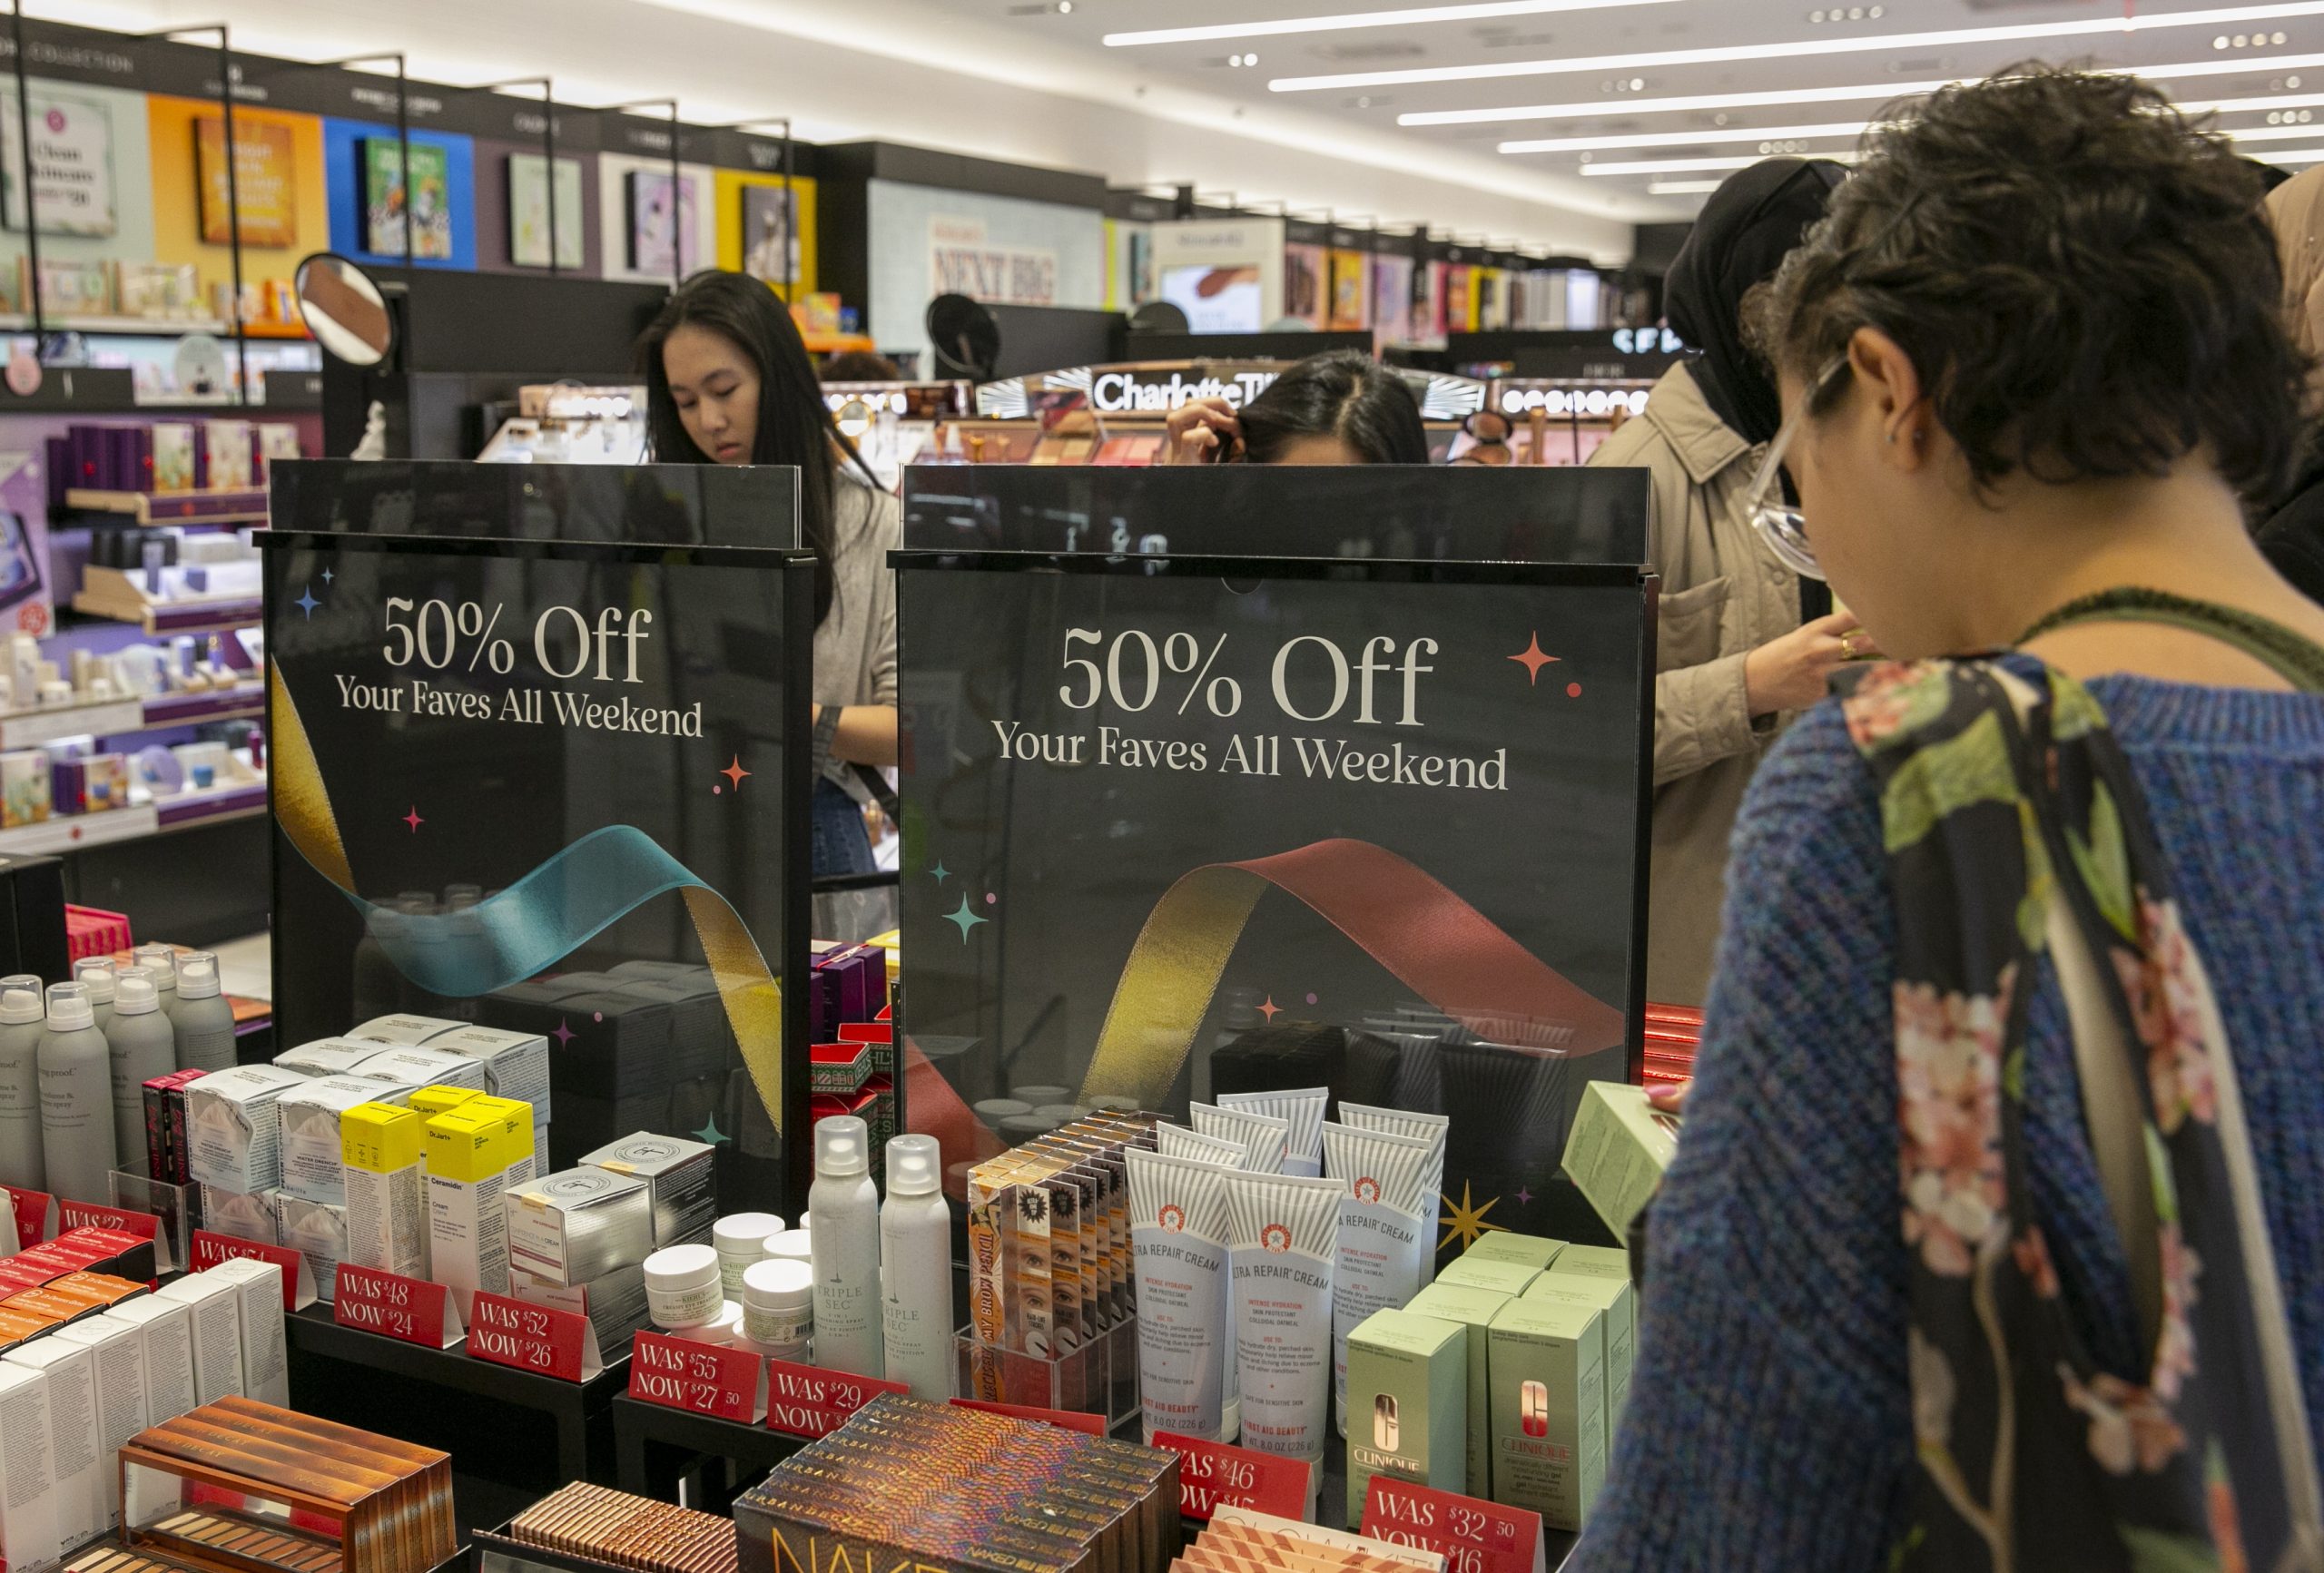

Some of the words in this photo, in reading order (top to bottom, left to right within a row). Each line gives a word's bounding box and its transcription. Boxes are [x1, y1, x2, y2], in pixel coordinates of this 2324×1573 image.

[383, 596, 515, 673] 50%
[534, 605, 652, 683] Off
[1059, 627, 1242, 718] 50%
[1272, 634, 1439, 727] Off
[335, 674, 404, 713] Your
[412, 681, 490, 720] Faves
[499, 688, 543, 723] All
[551, 692, 703, 737] Weekend
[992, 721, 1084, 765] Your
[1098, 727, 1206, 771] Faves
[1218, 734, 1280, 777] All
[1293, 737, 1508, 791] Weekend
[431, 1177, 462, 1191] Ceramidin
[65, 1209, 99, 1228] WAS
[1346, 1215, 1377, 1231] REPAIR
[1381, 1223, 1414, 1244] CREAM
[200, 1239, 237, 1262] WAS
[979, 1234, 994, 1276] PENCIL
[1151, 1244, 1181, 1260] REPAIR
[1185, 1252, 1219, 1272] CREAM
[342, 1273, 380, 1299] WAS
[384, 1281, 408, 1305] $48
[817, 1284, 862, 1296] TRIPLE
[1254, 1265, 1289, 1280] REPAIR
[1294, 1270, 1329, 1290] CREAM
[825, 1300, 851, 1310] SEC
[980, 1277, 993, 1315] BROW
[340, 1301, 385, 1325] NOW
[389, 1310, 412, 1334] $24
[480, 1303, 518, 1329] WAS
[523, 1311, 547, 1336] $52
[885, 1305, 919, 1321] RIPLE
[982, 1318, 994, 1341] MY
[475, 1330, 523, 1357] NOW
[526, 1341, 551, 1367] $26
[641, 1344, 684, 1371] WAS
[689, 1352, 717, 1380] $55
[636, 1372, 689, 1401] NOW
[691, 1383, 718, 1410] $27
[725, 1391, 740, 1405] 50
[777, 1374, 824, 1401] WAS
[831, 1382, 861, 1408] $29
[774, 1404, 830, 1432] NOW
[1167, 1403, 1196, 1413] BEAUTY
[1167, 1418, 1176, 1428] OZ
[1244, 1420, 1260, 1432] FIRST
[1262, 1426, 1273, 1434] AID
[1276, 1427, 1305, 1435] BEAUTY
[826, 1435, 883, 1452] URBAN
[1275, 1440, 1285, 1452] OZ
[1287, 1441, 1305, 1452] (226
[1502, 1438, 1570, 1460] CLINIQUE
[803, 1447, 860, 1466] URBAN
[1354, 1449, 1419, 1471] CLINIQUE
[782, 1461, 839, 1480] URBAN
[1220, 1459, 1255, 1489] $46
[743, 1491, 803, 1512] URBAN
[1000, 1512, 1049, 1530] NAKED
[1376, 1490, 1434, 1526] WAS
[1449, 1506, 1486, 1541] $32
[1497, 1521, 1515, 1538] 50
[966, 1546, 1017, 1566] NAKED
[1371, 1525, 1440, 1553] NOW
[1449, 1545, 1482, 1573] $16
